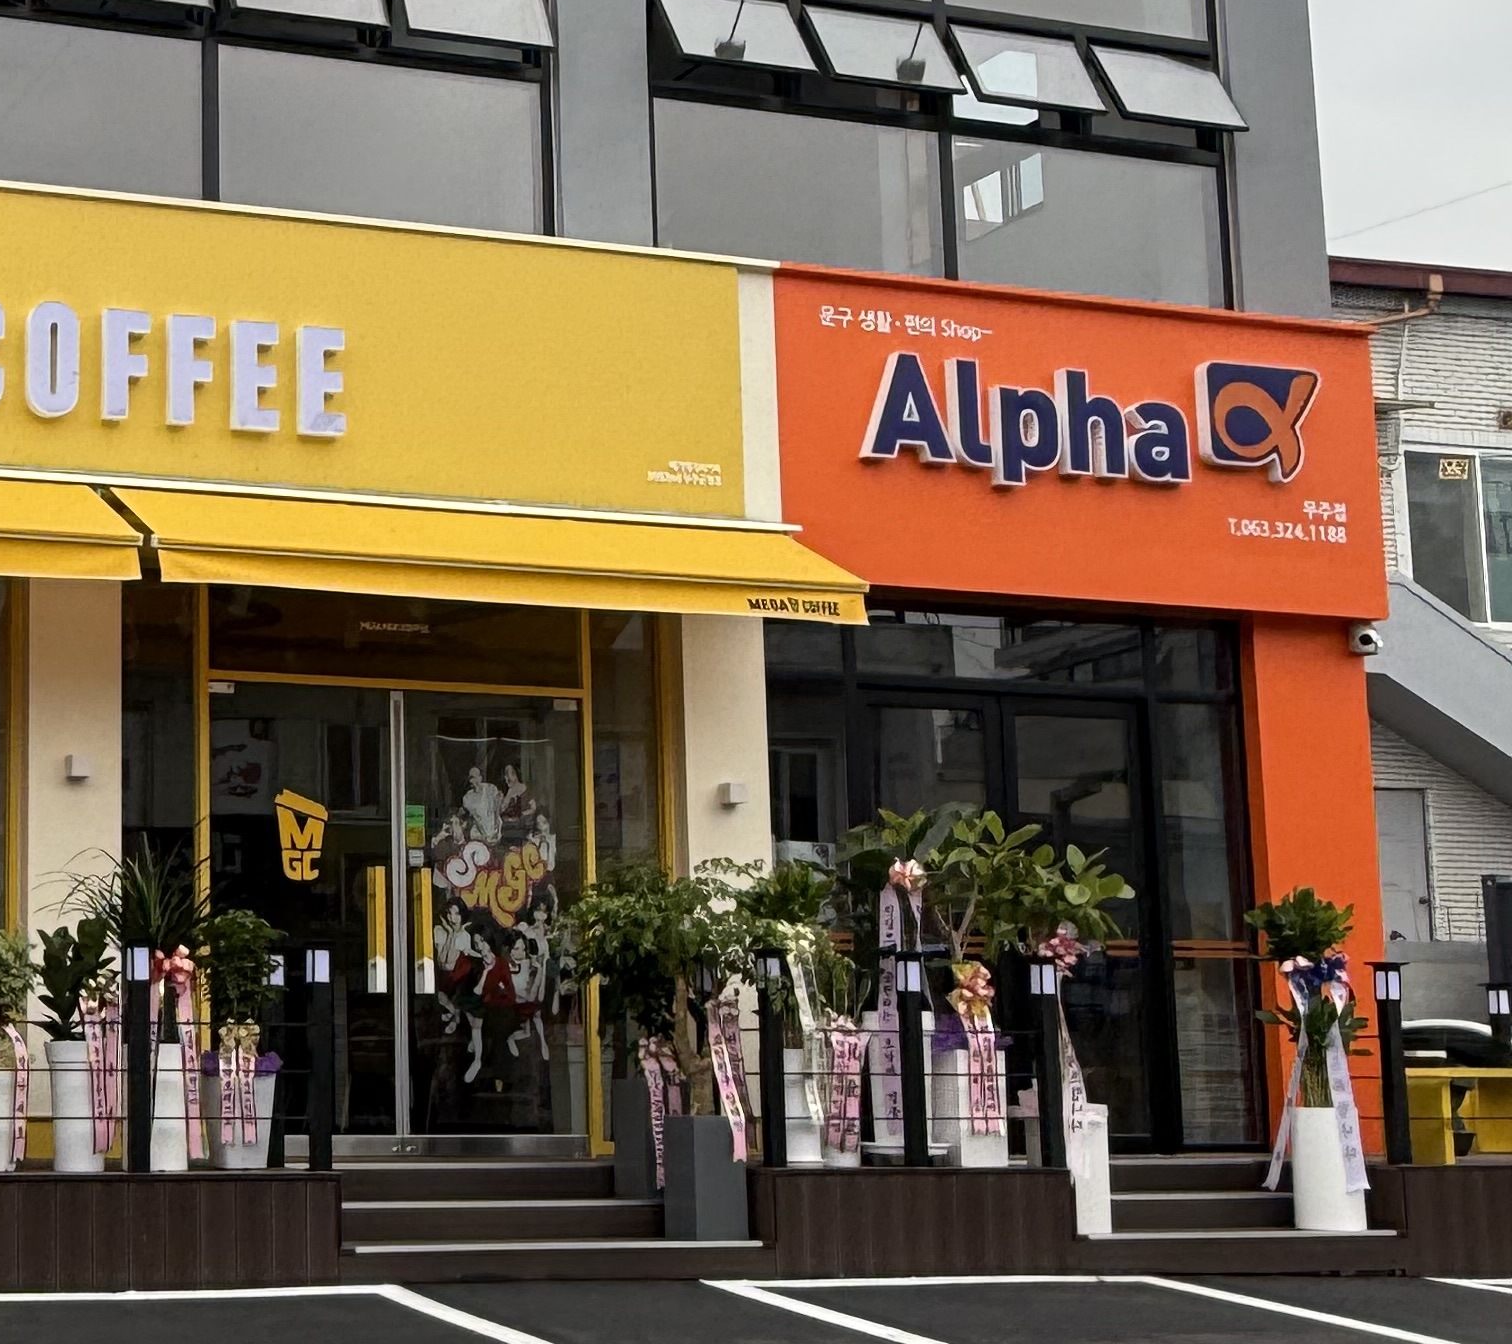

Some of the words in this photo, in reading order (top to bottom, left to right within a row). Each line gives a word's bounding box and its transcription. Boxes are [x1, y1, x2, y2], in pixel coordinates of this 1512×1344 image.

[820, 305, 854, 328] 문구
[859, 351, 1192, 486] Alpha
[1302, 500, 1347, 523] 무주점
